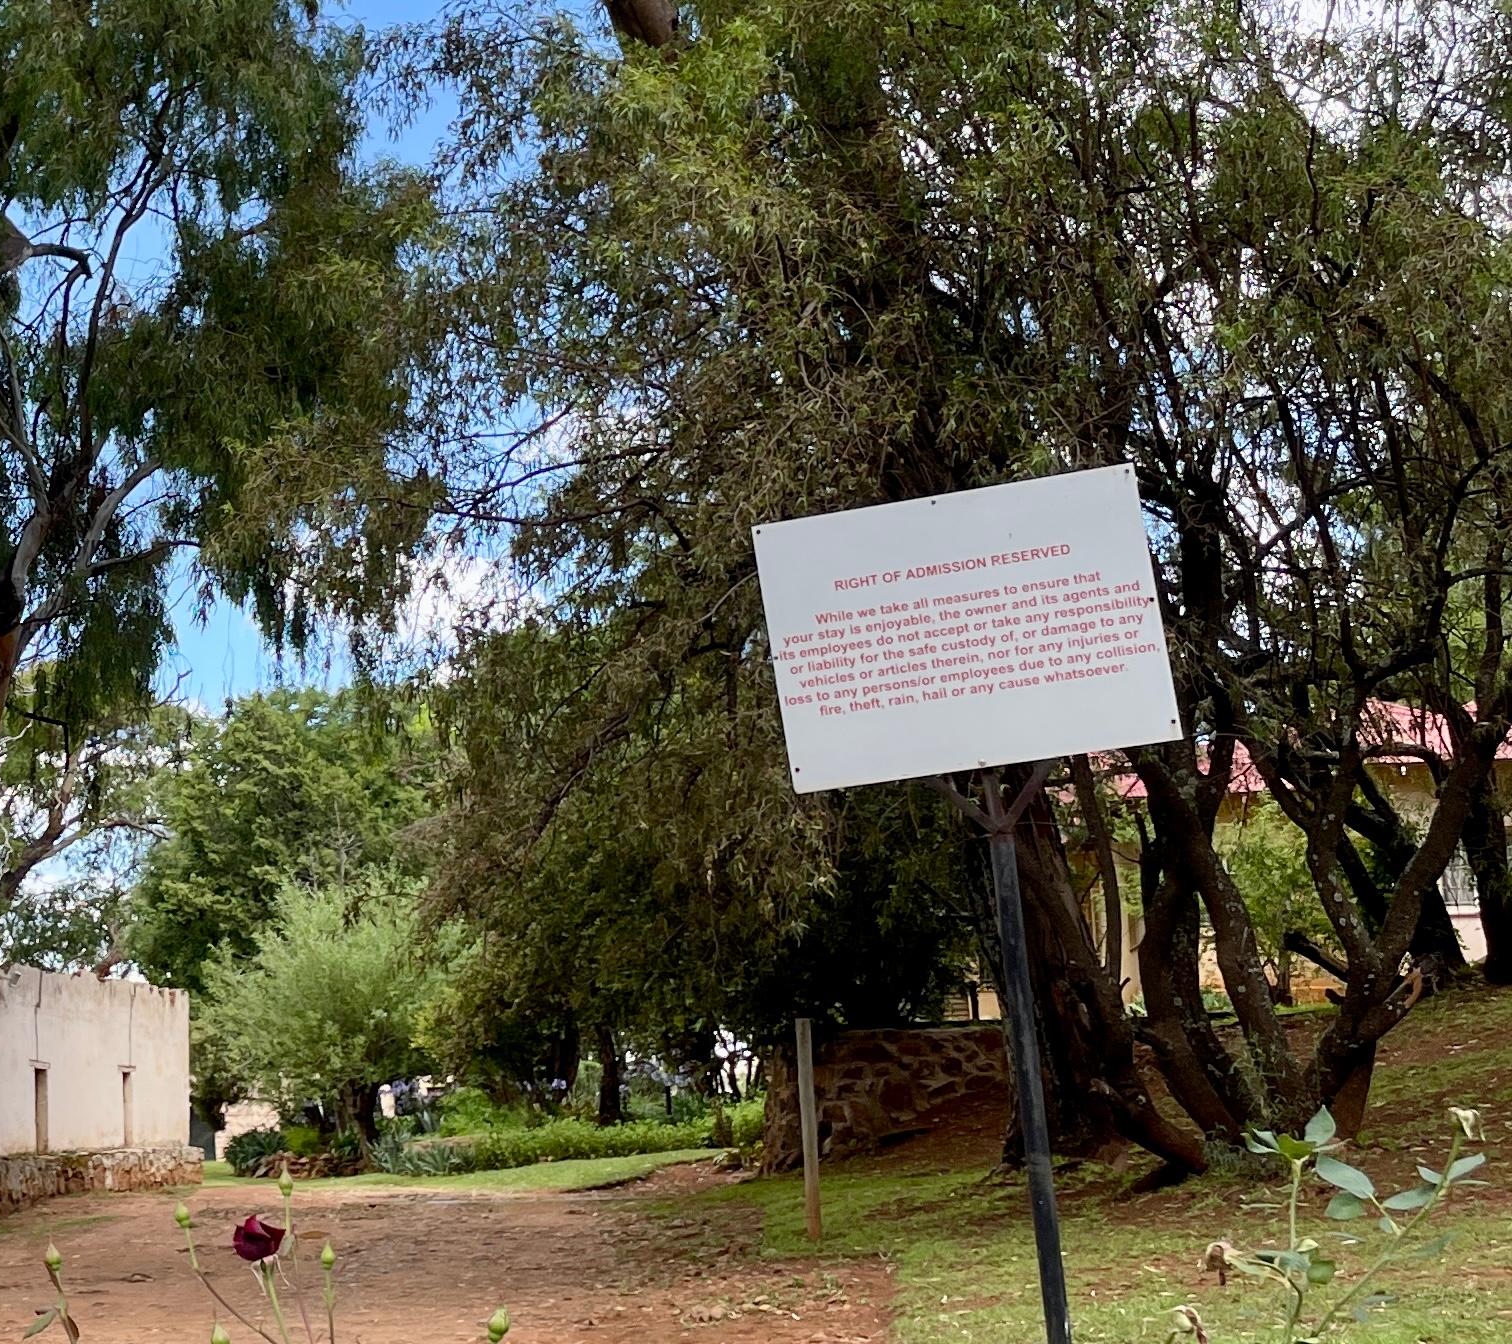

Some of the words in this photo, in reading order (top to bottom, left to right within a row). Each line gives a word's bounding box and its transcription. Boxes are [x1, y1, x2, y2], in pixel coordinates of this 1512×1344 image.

[814, 610, 854, 625] While
[856, 608, 877, 619] we
[879, 602, 910, 615] take
[912, 597, 929, 610] all
[932, 588, 1001, 607] measures
[1003, 585, 1018, 596] to
[1021, 577, 1070, 593] ensure
[1073, 570, 1101, 585] that
[833, 574, 878, 592] RIGHT
[881, 570, 902, 584] OF
[905, 556, 987, 581] ADMISSION
[990, 543, 1071, 567] RESERVED
[778, 650, 796, 662] its
[799, 639, 873, 658] employees
[875, 634, 894, 647] do
[897, 630, 921, 644] not
[923, 622, 971, 639] accept
[973, 621, 988, 632] or
[991, 615, 1022, 629] take
[1024, 611, 1050, 624] any
[1053, 595, 1150, 620] responsibility
[782, 633, 814, 648] your
[817, 628, 846, 641] stay
[849, 624, 862, 635] is
[865, 613, 936, 633] enjoyable,
[938, 609, 961, 622] the
[964, 602, 1008, 617] owner
[1011, 595, 1038, 610] and
[1040, 594, 1059, 606] its
[1062, 586, 1111, 604] agents
[1113, 579, 1141, 595] and
[789, 664, 805, 675] or
[807, 656, 856, 673] liability
[859, 653, 880, 665] for
[882, 649, 905, 661] the
[908, 643, 938, 657] safe
[940, 634, 996, 652] custody
[1000, 630, 1019, 643] of,
[1022, 629, 1038, 640] or
[1040, 620, 1097, 637] damage
[1099, 617, 1115, 628] to
[1118, 613, 1144, 625] any
[783, 694, 814, 707] loss
[815, 690, 831, 703] to
[833, 687, 858, 700] any
[861, 674, 937, 697] persons/or
[939, 663, 1016, 684] employees
[1018, 659, 1046, 673] due
[1047, 655, 1065, 668] to
[1066, 651, 1092, 665] any
[1095, 642, 1161, 660] collision,
[799, 672, 856, 689] vehicles
[858, 669, 874, 680] or
[877, 661, 928, 678] articles
[930, 652, 984, 670] therein,
[987, 648, 1011, 661] nor
[1014, 644, 1035, 656] for
[1038, 641, 1064, 653] any
[1066, 632, 1121, 649] injuries
[1123, 629, 1139, 640] or
[819, 704, 847, 717] fire,
[848, 697, 885, 713] theft,
[887, 693, 920, 707] rain,
[921, 687, 948, 703] hail
[950, 686, 967, 697] or
[968, 682, 995, 695] any
[998, 675, 1041, 691] cause
[1042, 663, 1129, 684] whatsoever.
